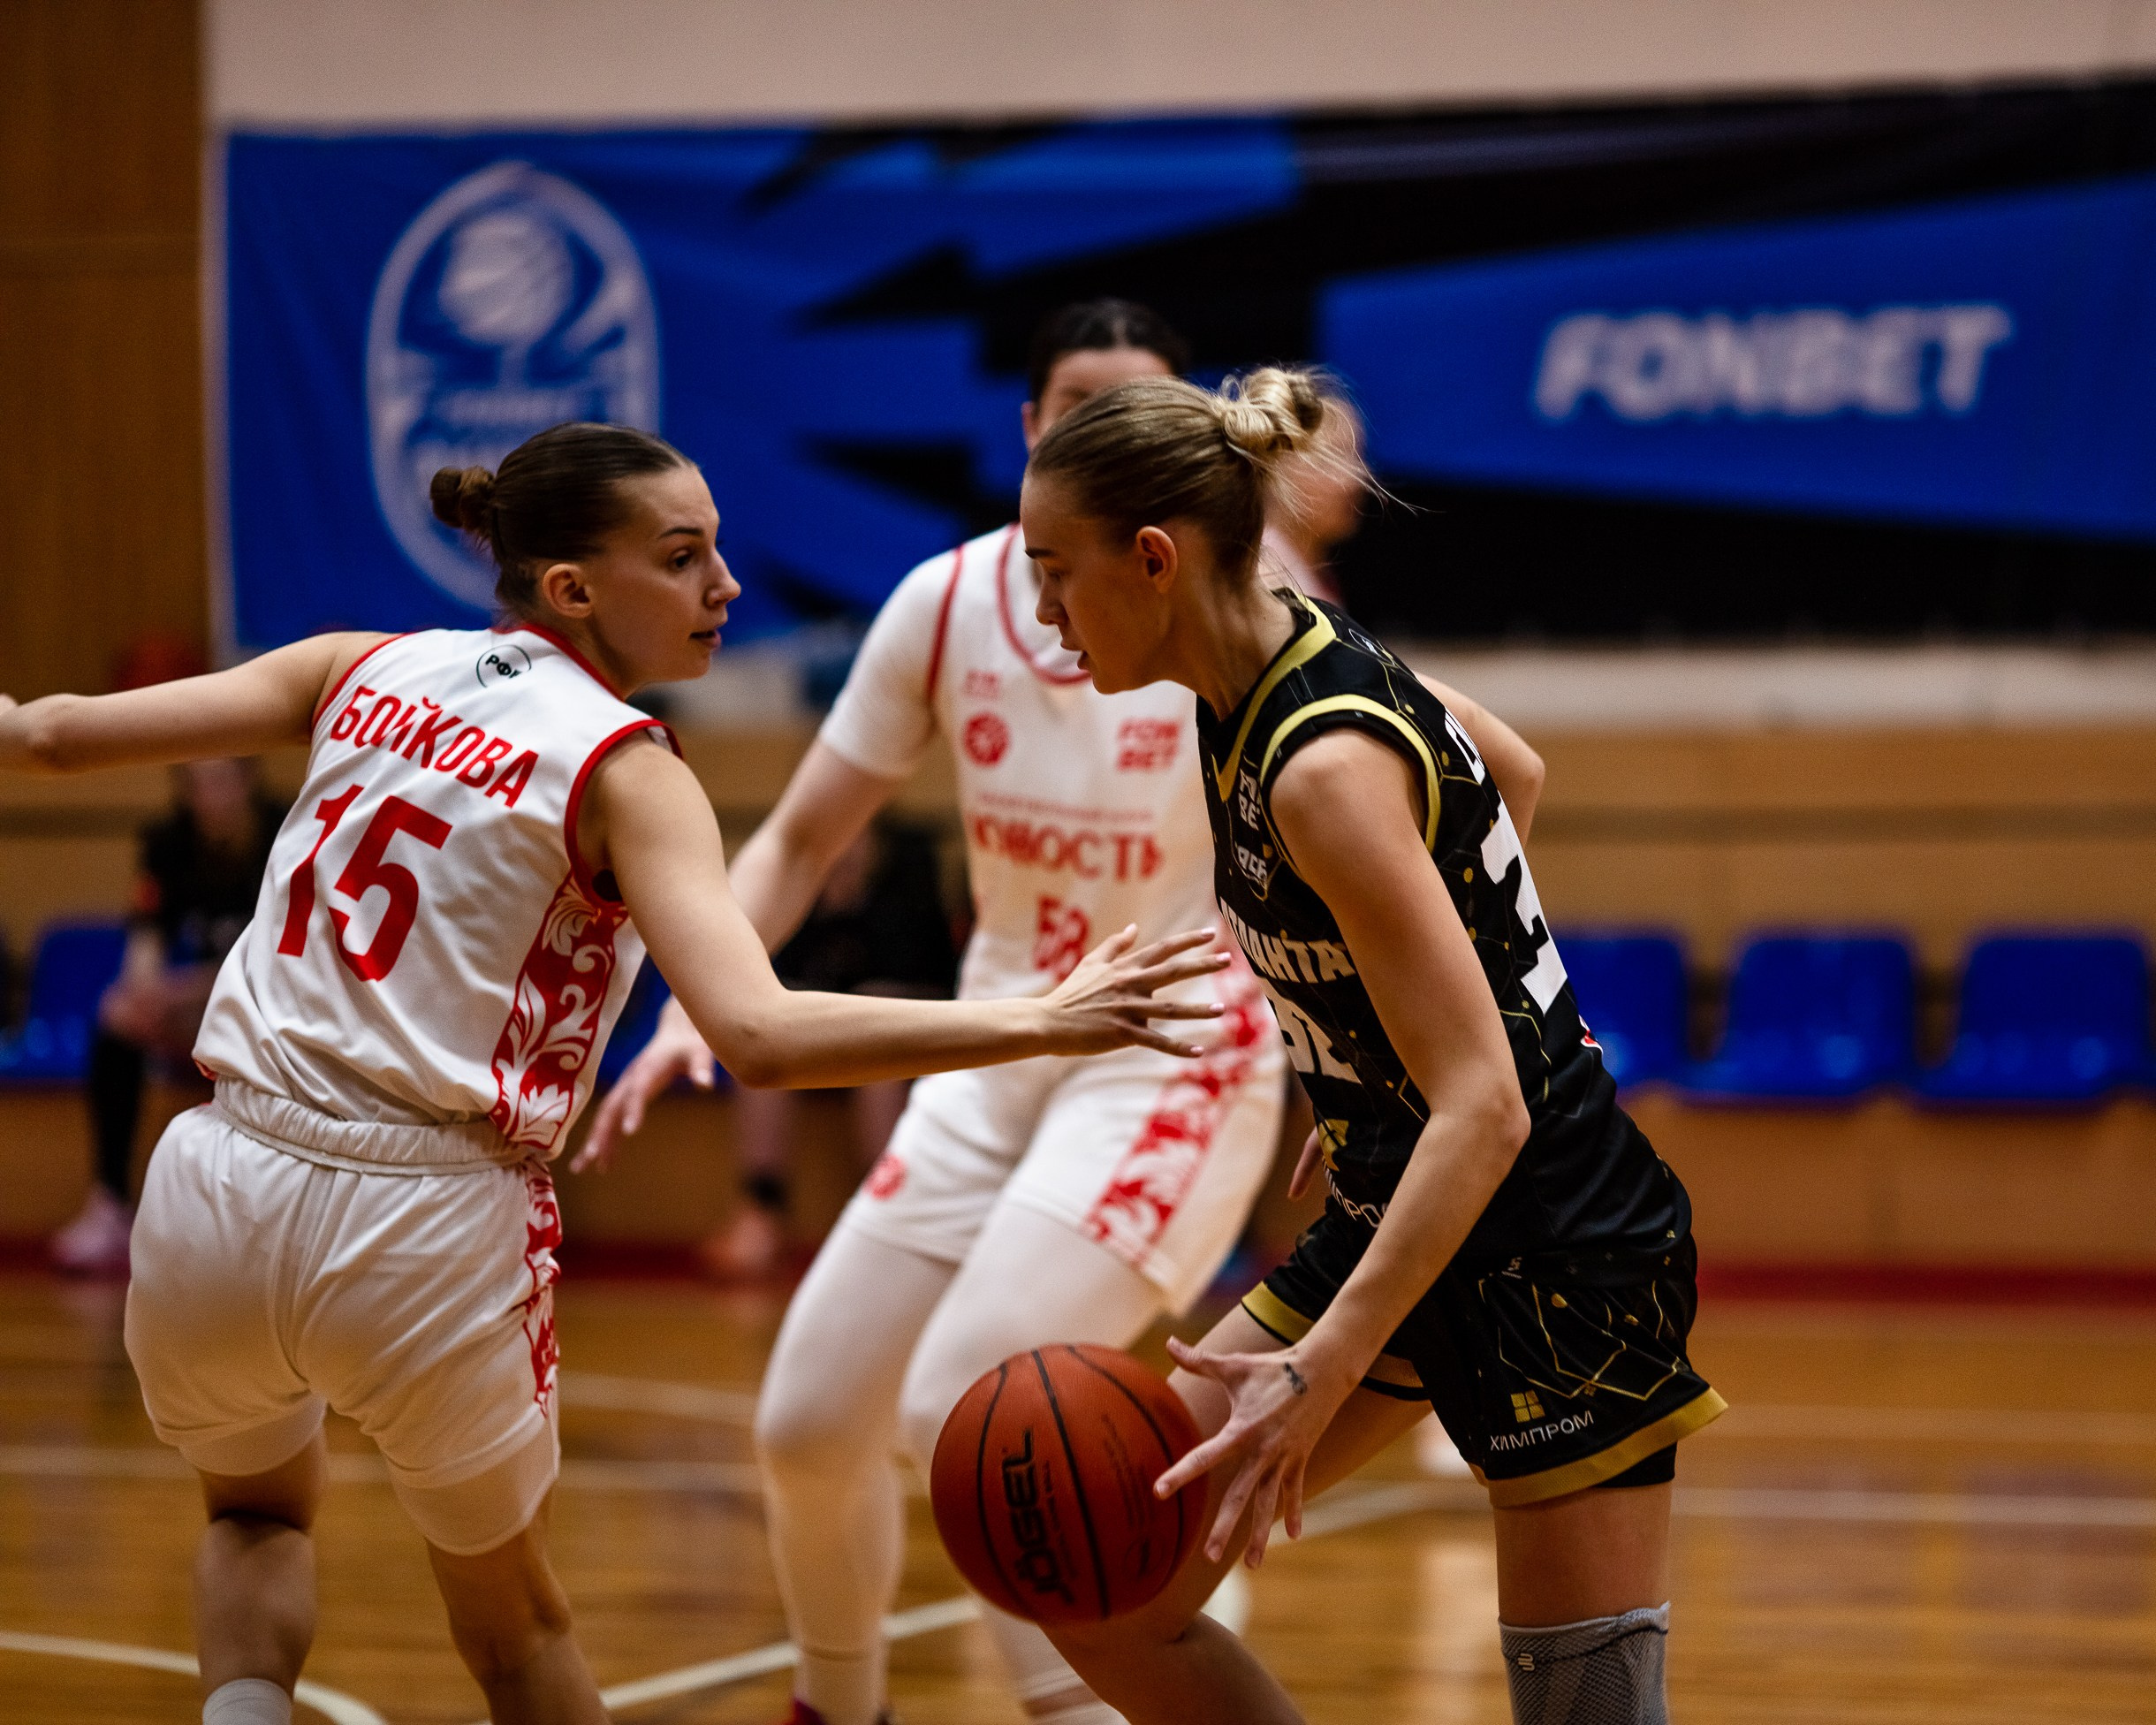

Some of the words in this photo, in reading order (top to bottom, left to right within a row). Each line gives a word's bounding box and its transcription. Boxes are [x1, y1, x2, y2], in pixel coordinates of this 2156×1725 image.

[1532, 304, 2012, 420] FONBET
[330, 686, 539, 809] БОЙКОВА
[277, 784, 452, 982] 15
[1490, 1410, 1595, 1452] ХИМПРОМ
